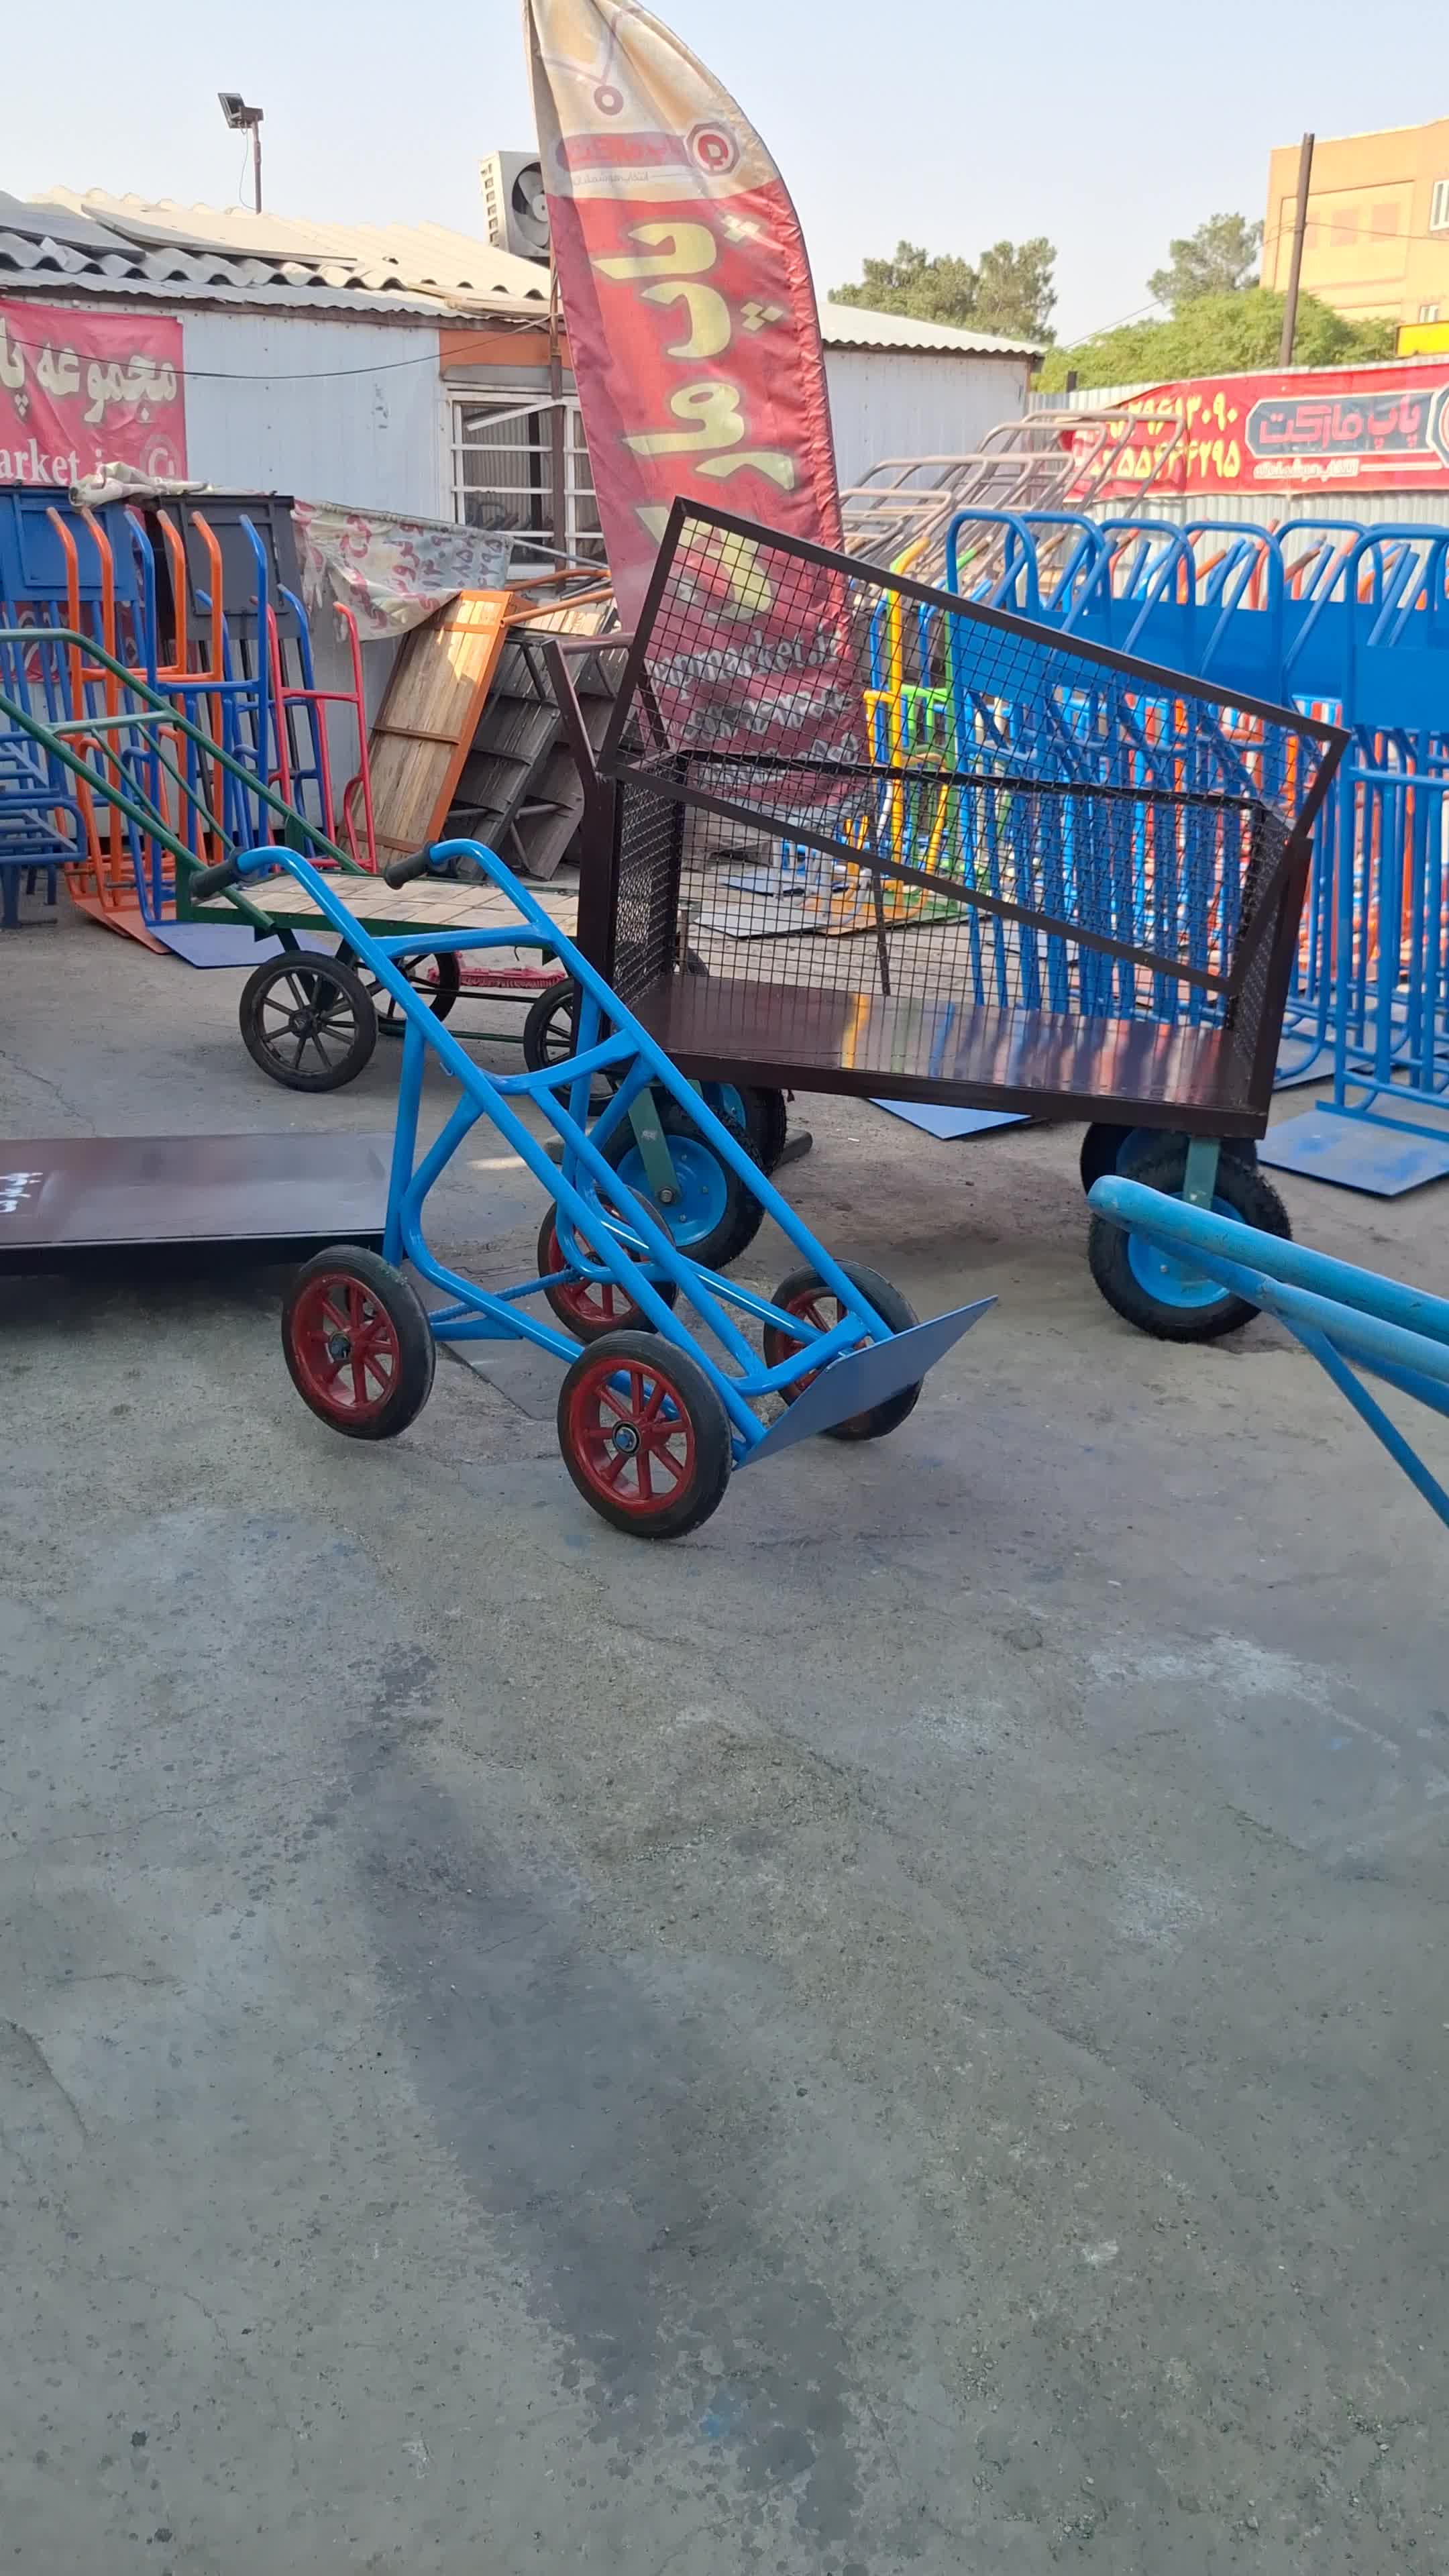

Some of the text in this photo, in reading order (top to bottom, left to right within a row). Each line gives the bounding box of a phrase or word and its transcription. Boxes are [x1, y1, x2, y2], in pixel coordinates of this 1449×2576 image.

[590, 213, 785, 359] پاپ
[1259, 394, 1421, 450] پاپ مارکت
